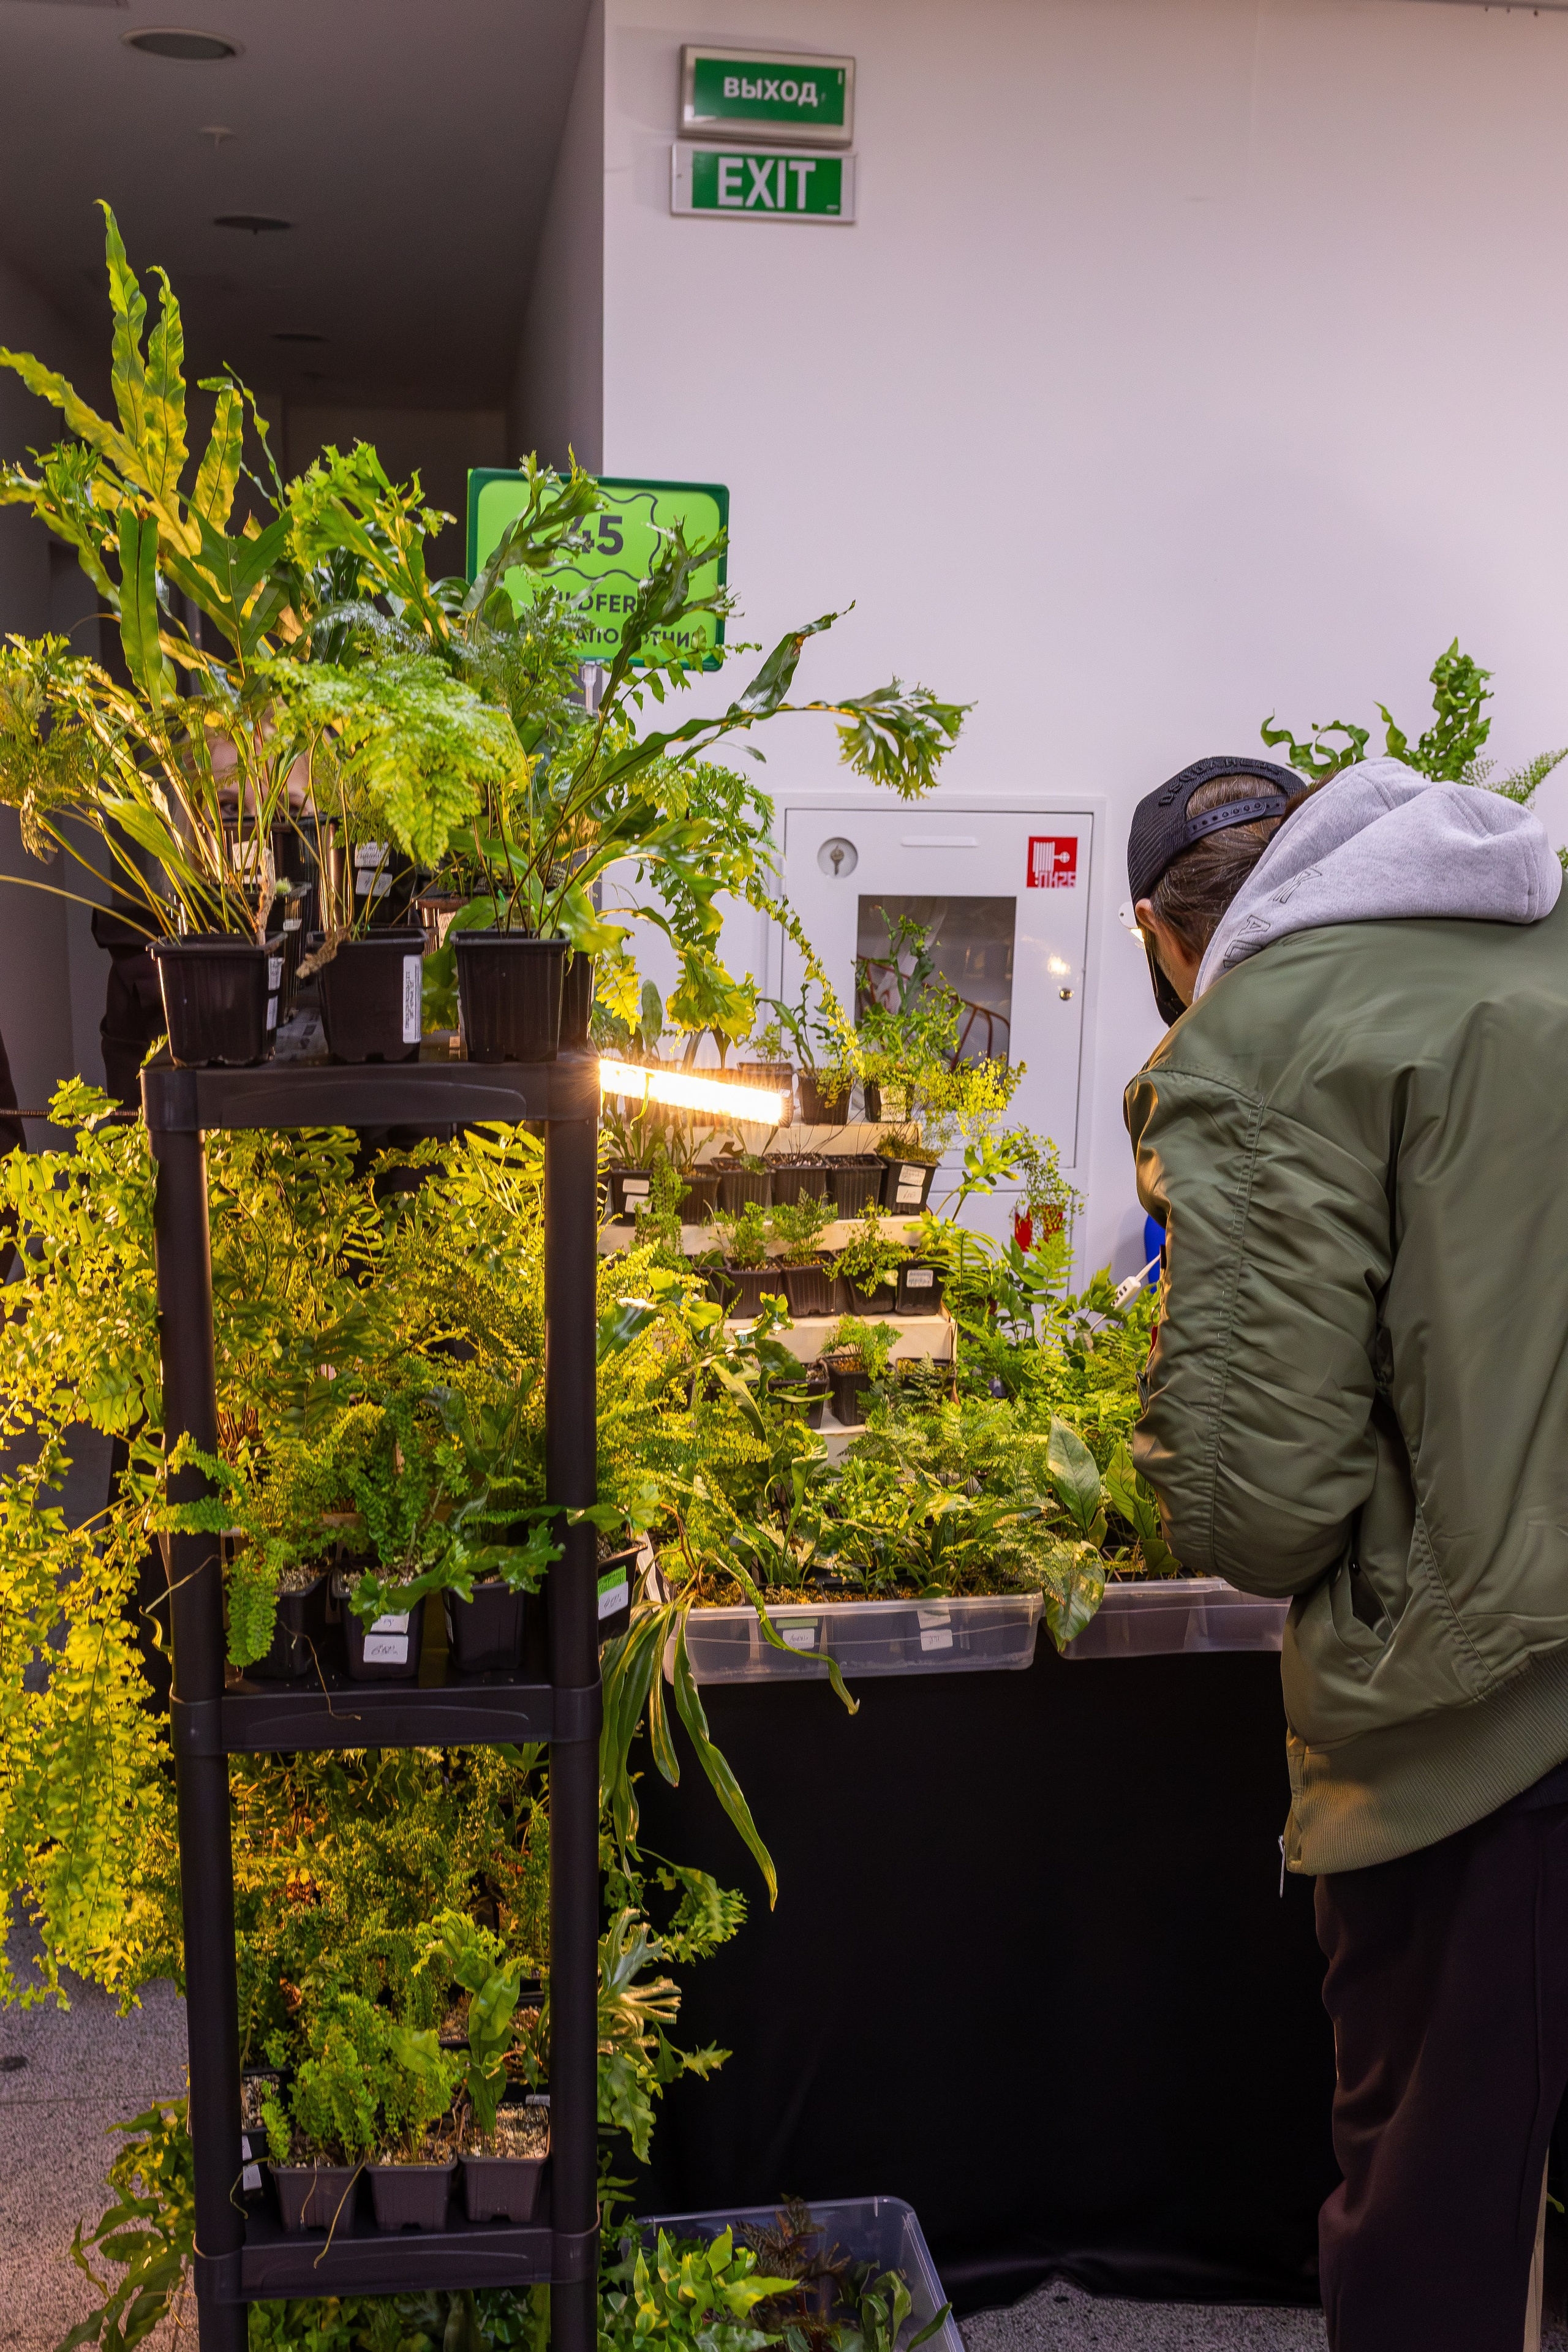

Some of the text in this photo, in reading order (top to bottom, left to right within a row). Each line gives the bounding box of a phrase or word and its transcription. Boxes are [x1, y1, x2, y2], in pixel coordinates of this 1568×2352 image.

[723, 76, 818, 107] ВЫХОД
[717, 157, 816, 210] EXIT
[568, 514, 624, 556] 45
